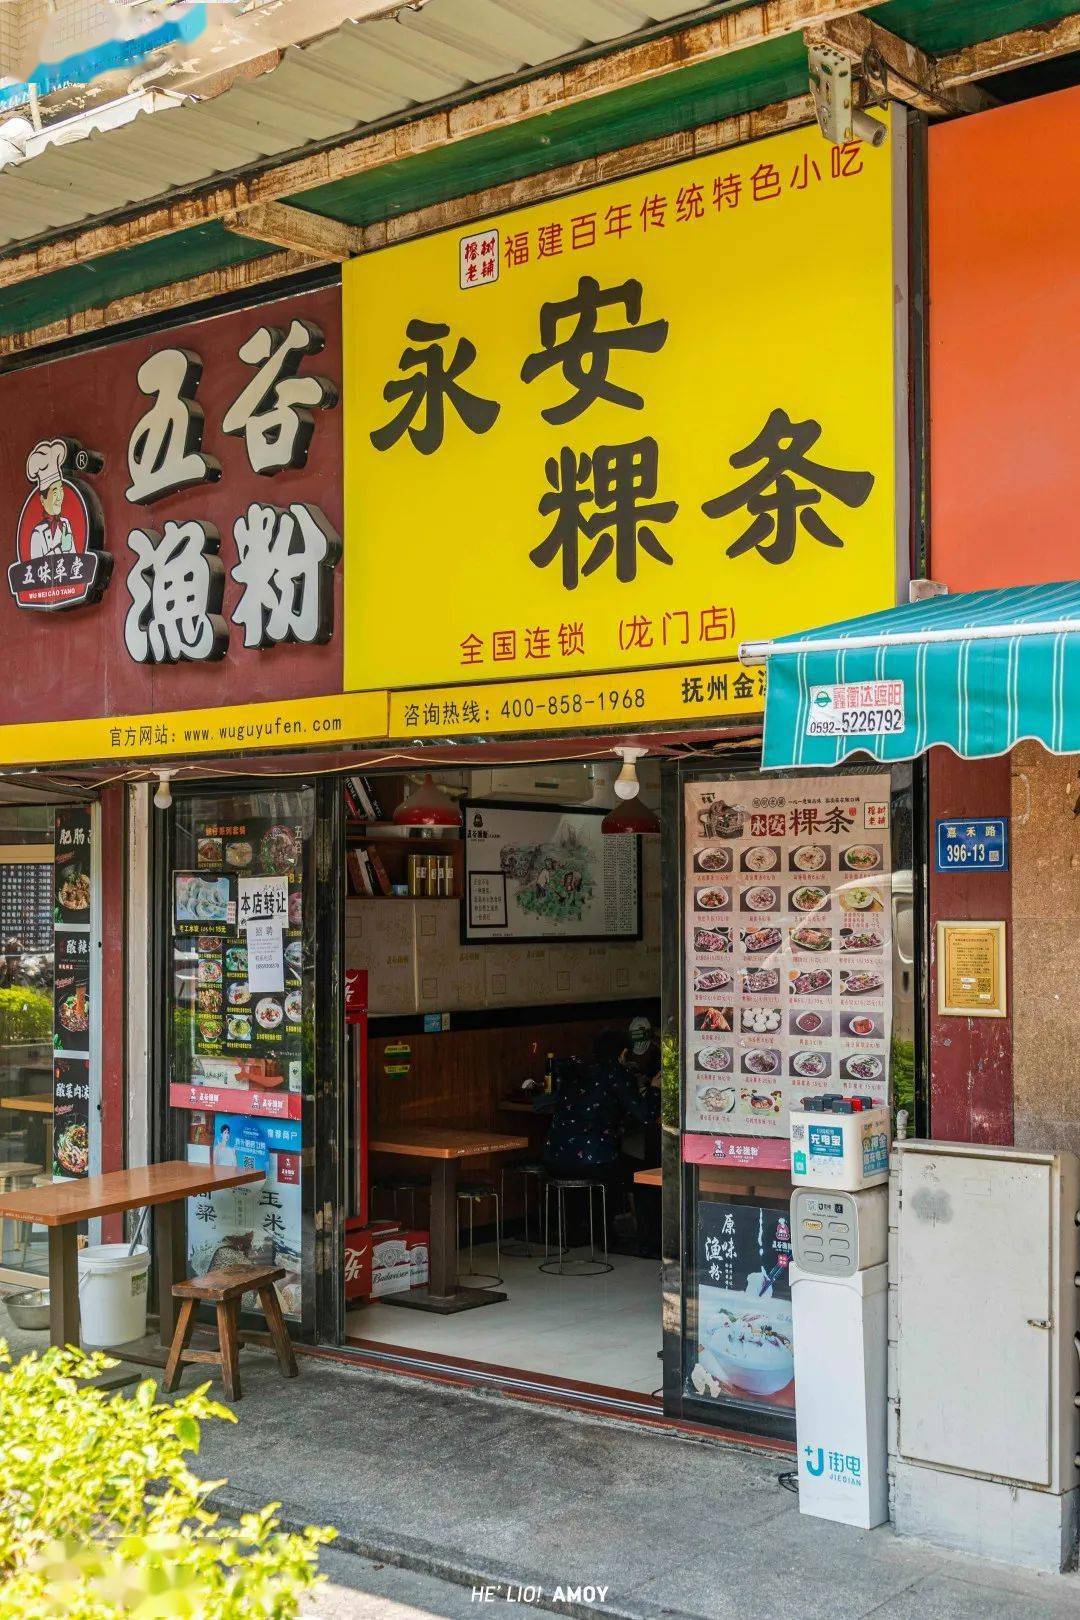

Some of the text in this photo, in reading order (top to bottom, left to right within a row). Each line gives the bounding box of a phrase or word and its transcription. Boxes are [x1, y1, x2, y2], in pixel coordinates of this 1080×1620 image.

[505, 140, 865, 268] 福建百年传统特色小吃
[370, 275, 669, 455] 永安
[125, 318, 334, 505] 五谷
[529, 408, 875, 591] 粿条
[460, 622, 585, 666] 全国连锁
[810, 709, 902, 734] 0592-5226792
[946, 825, 997, 838] 嘉禾路
[947, 843, 986, 863] 396-13
[240, 891, 287, 915] 本店转让
[266, 1128, 298, 1141] 推荐商户
[810, 1134, 841, 1146] 充电宝
[259, 1190, 287, 1231] 玉米
[721, 1213, 738, 1260] 原味
[828, 1452, 861, 1477] 街电
[829, 1474, 862, 1486] JIEDIAN
